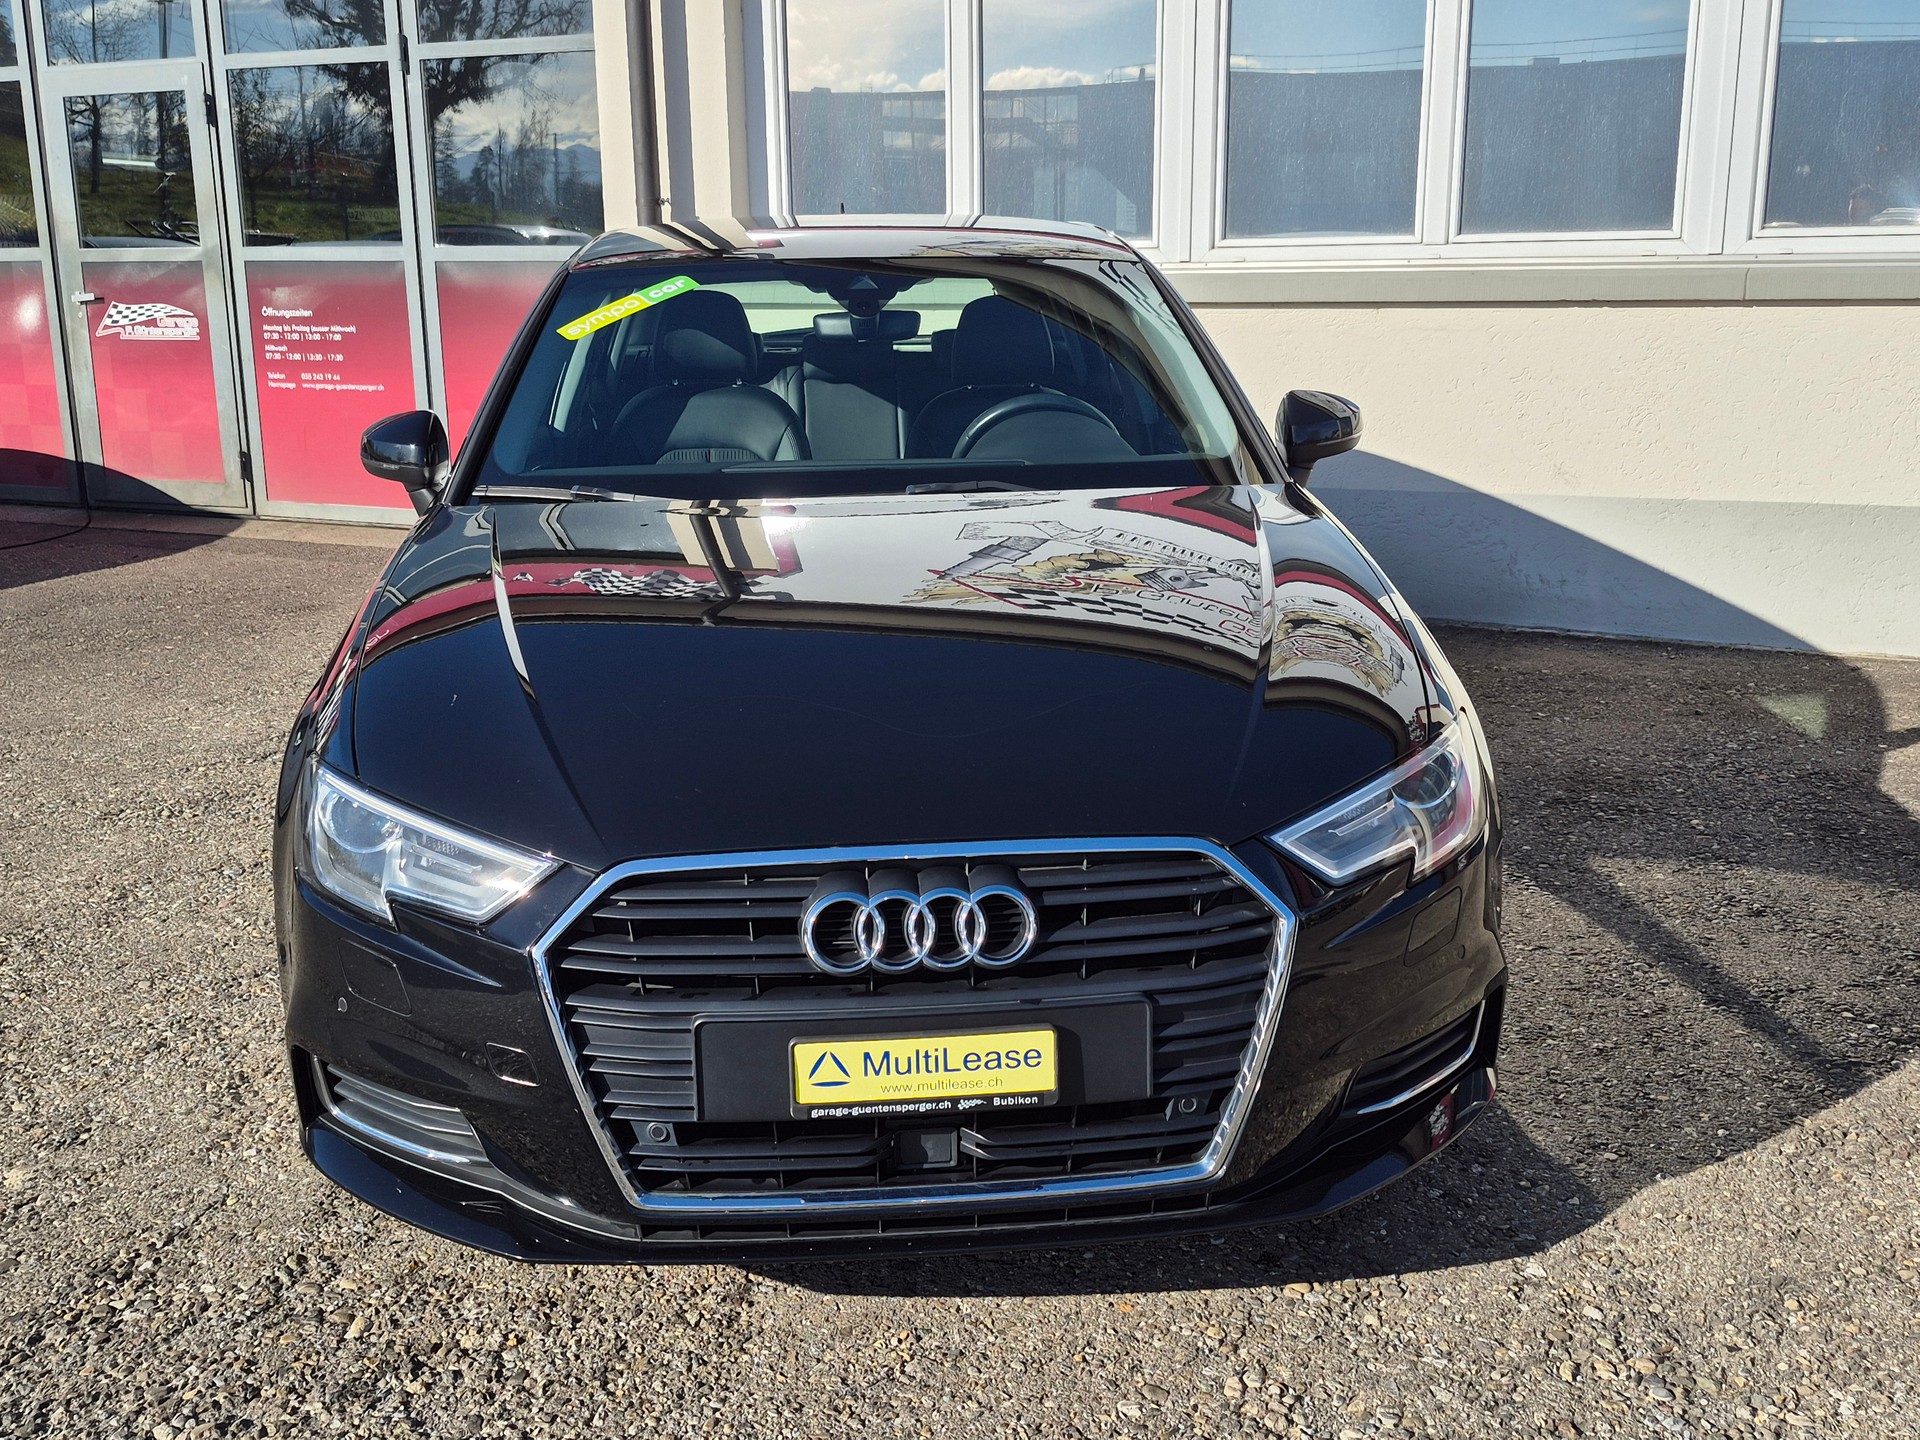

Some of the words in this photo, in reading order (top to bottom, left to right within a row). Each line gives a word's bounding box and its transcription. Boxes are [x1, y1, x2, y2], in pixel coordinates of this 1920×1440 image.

[261, 305, 313, 319] Öffnungszeiten
[567, 299, 641, 336] sympa
[649, 279, 685, 298] car
[157, 316, 199, 328] Garage
[263, 324, 282, 333] Montag
[283, 324, 292, 332] bis
[292, 324, 310, 333] Freitag
[330, 325, 357, 334] Mittwoch)
[263, 332, 280, 340] 07:30
[326, 333, 342, 341] 17:00
[265, 352, 281, 360] 07:30
[267, 371, 286, 380] Telefon
[268, 381, 296, 390] Homepage
[862, 1047, 1043, 1078] MultiLease
[880, 1077, 1004, 1094] www.multilease.ch
[811, 1100, 951, 1118] garage-guentensperger.ch
[993, 1095, 1038, 1107] Bubikon
